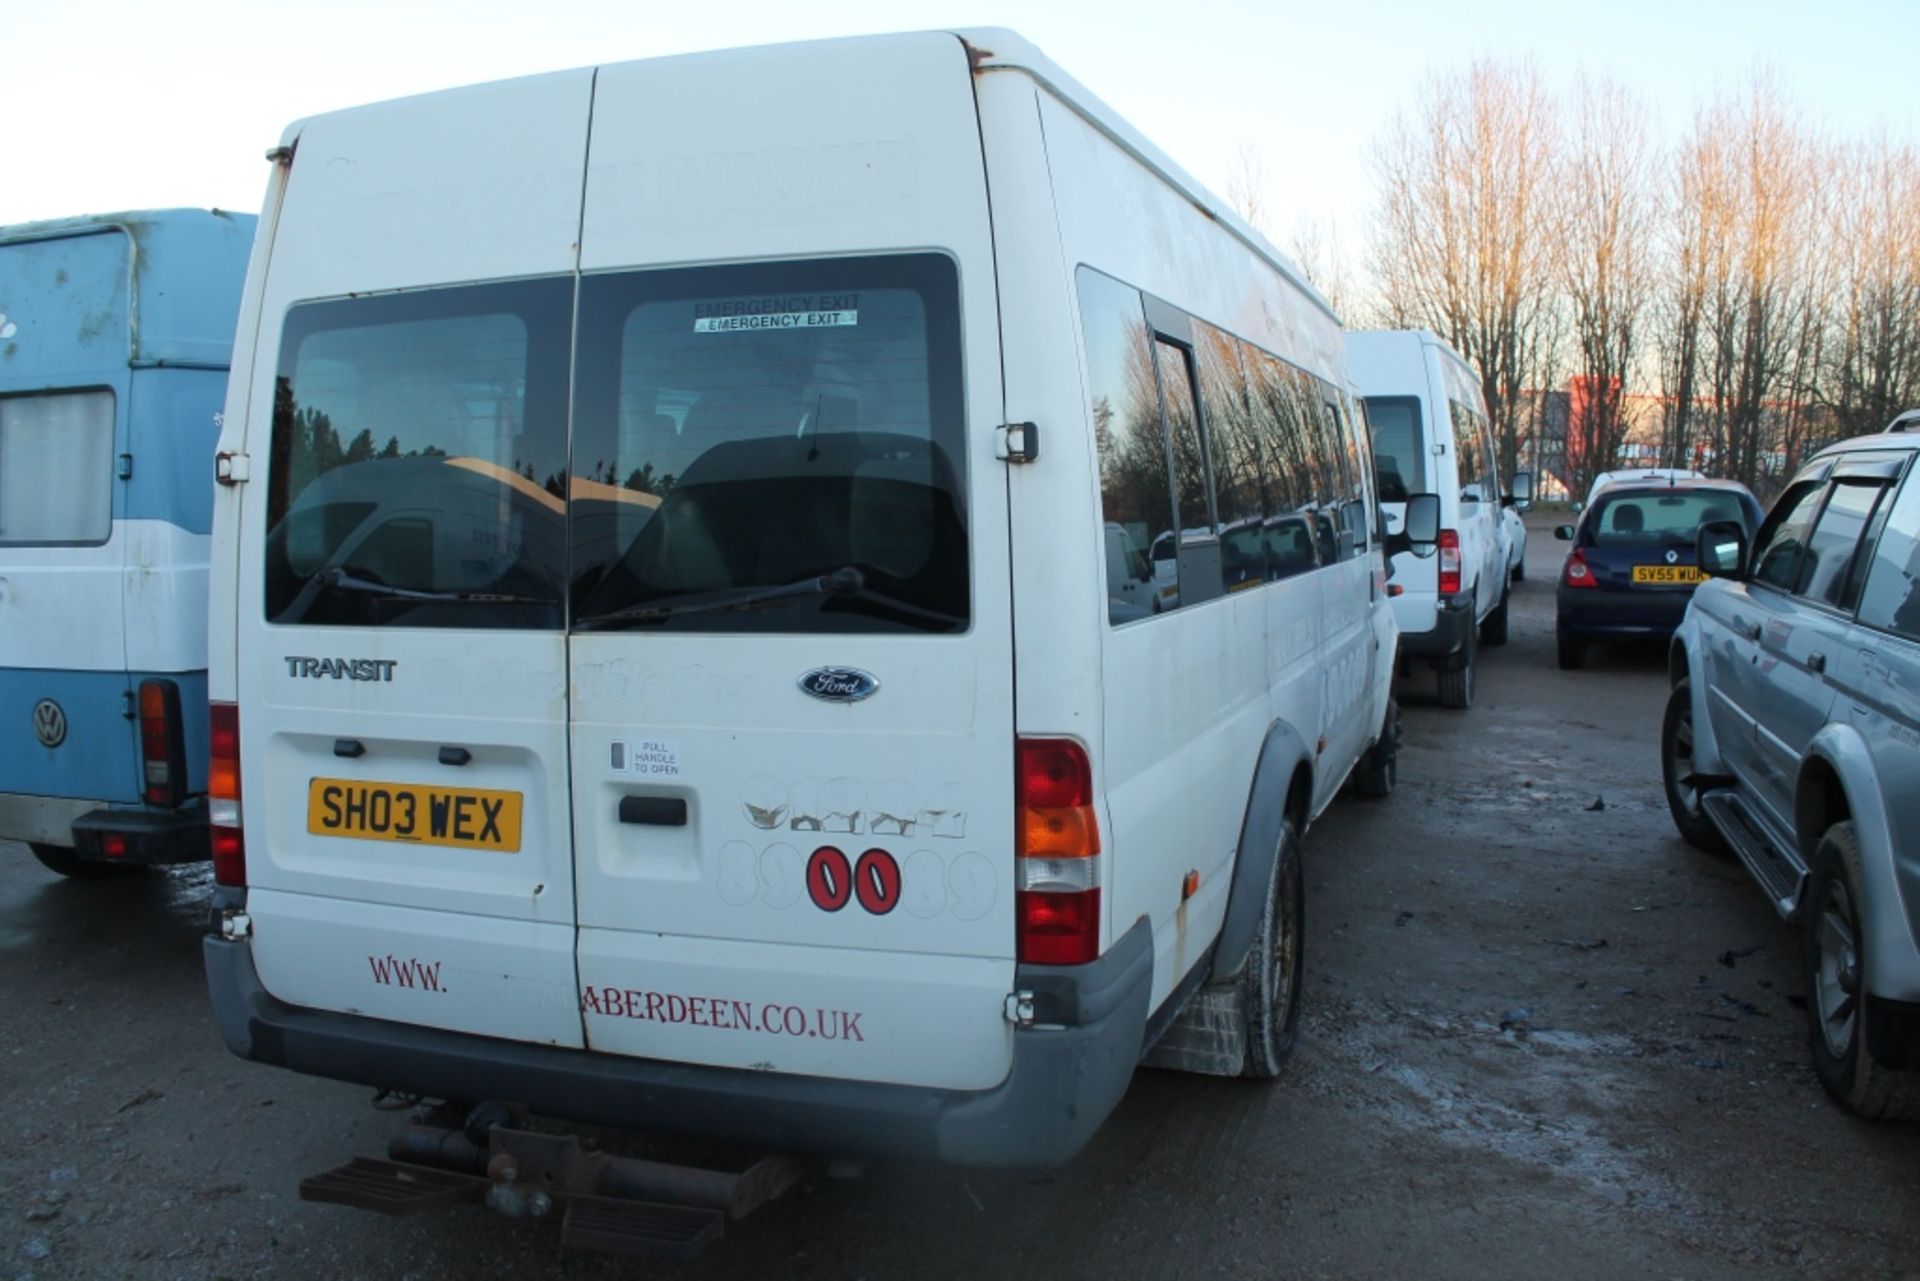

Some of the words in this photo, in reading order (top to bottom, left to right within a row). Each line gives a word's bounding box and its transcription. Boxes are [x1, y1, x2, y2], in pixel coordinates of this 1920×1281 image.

[694, 297, 812, 319] EMERGENCY
[820, 294, 862, 311] EXIT
[708, 315, 800, 331] EMERGENCY
[807, 313, 840, 326] EXIT
[284, 656, 398, 682] TRANSIT
[635, 753, 675, 764] HANDLE
[643, 742, 668, 752] PULL
[635, 763, 647, 773] TO
[651, 764, 678, 775] OPEN
[322, 786, 417, 834] SH03
[429, 793, 503, 842] WEX
[368, 954, 447, 992] WWW.
[581, 986, 865, 1041] ABERDEEN.CO.UK
